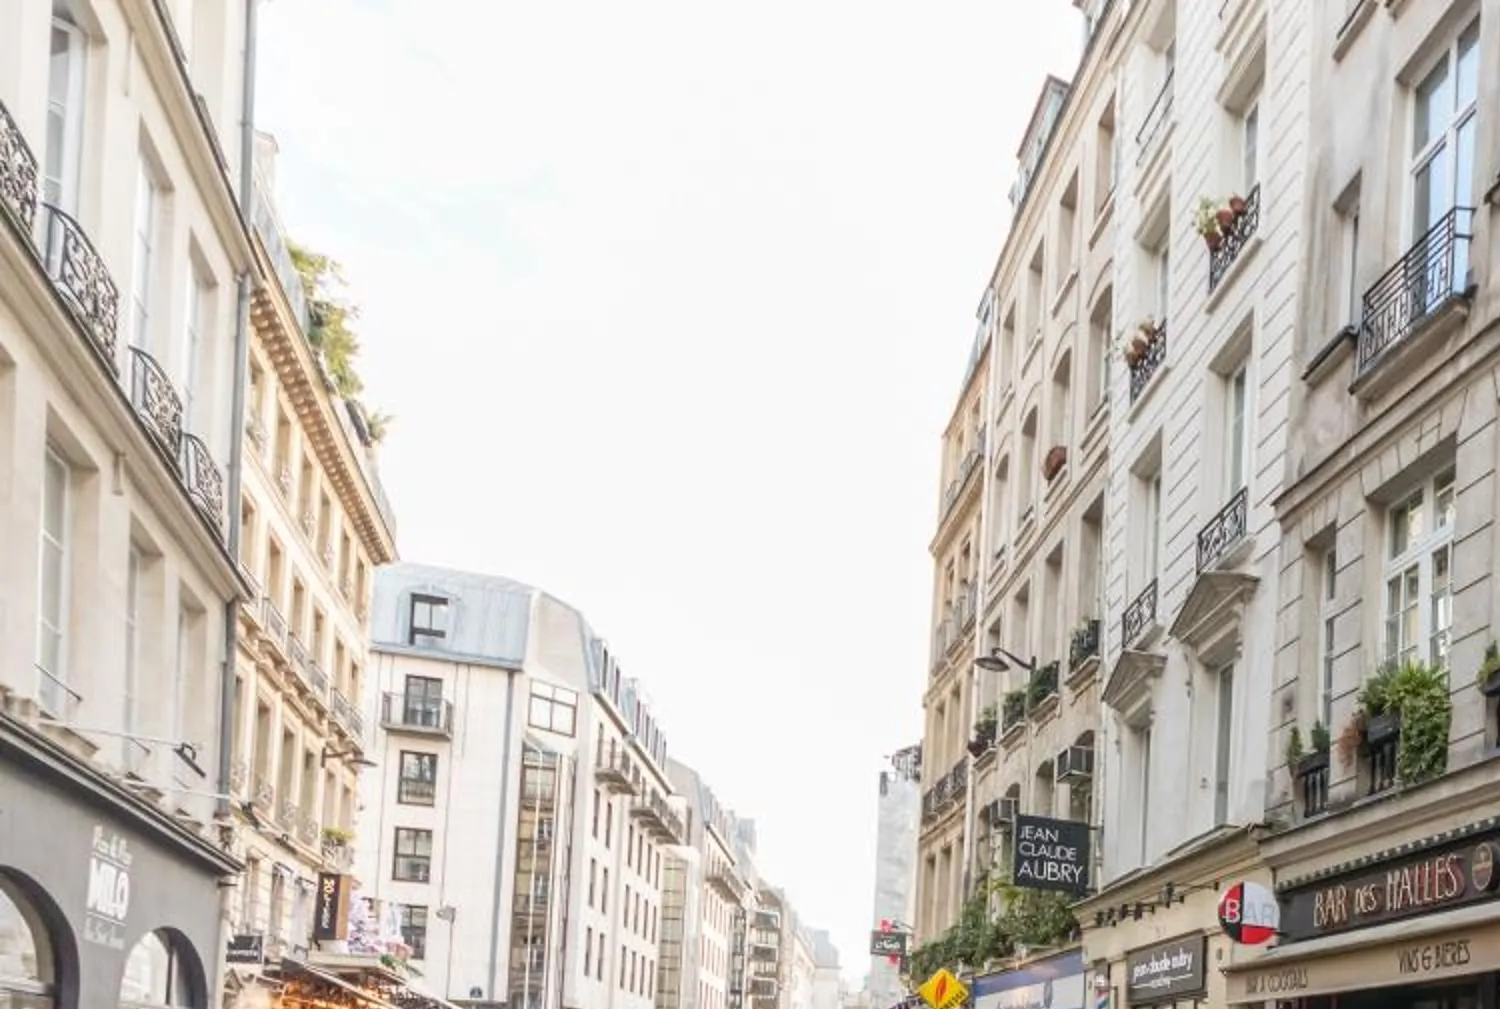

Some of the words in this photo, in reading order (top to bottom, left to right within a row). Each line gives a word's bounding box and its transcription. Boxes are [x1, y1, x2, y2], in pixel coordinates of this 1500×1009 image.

[1018, 825, 1059, 842] JEAN
[1018, 841, 1077, 861] CLAUDE
[1017, 860, 1084, 883] AUBRY
[1313, 885, 1348, 928] BAR
[1355, 882, 1377, 915] DES
[1385, 855, 1461, 912] HALLES
[1224, 898, 1279, 925] BAR
